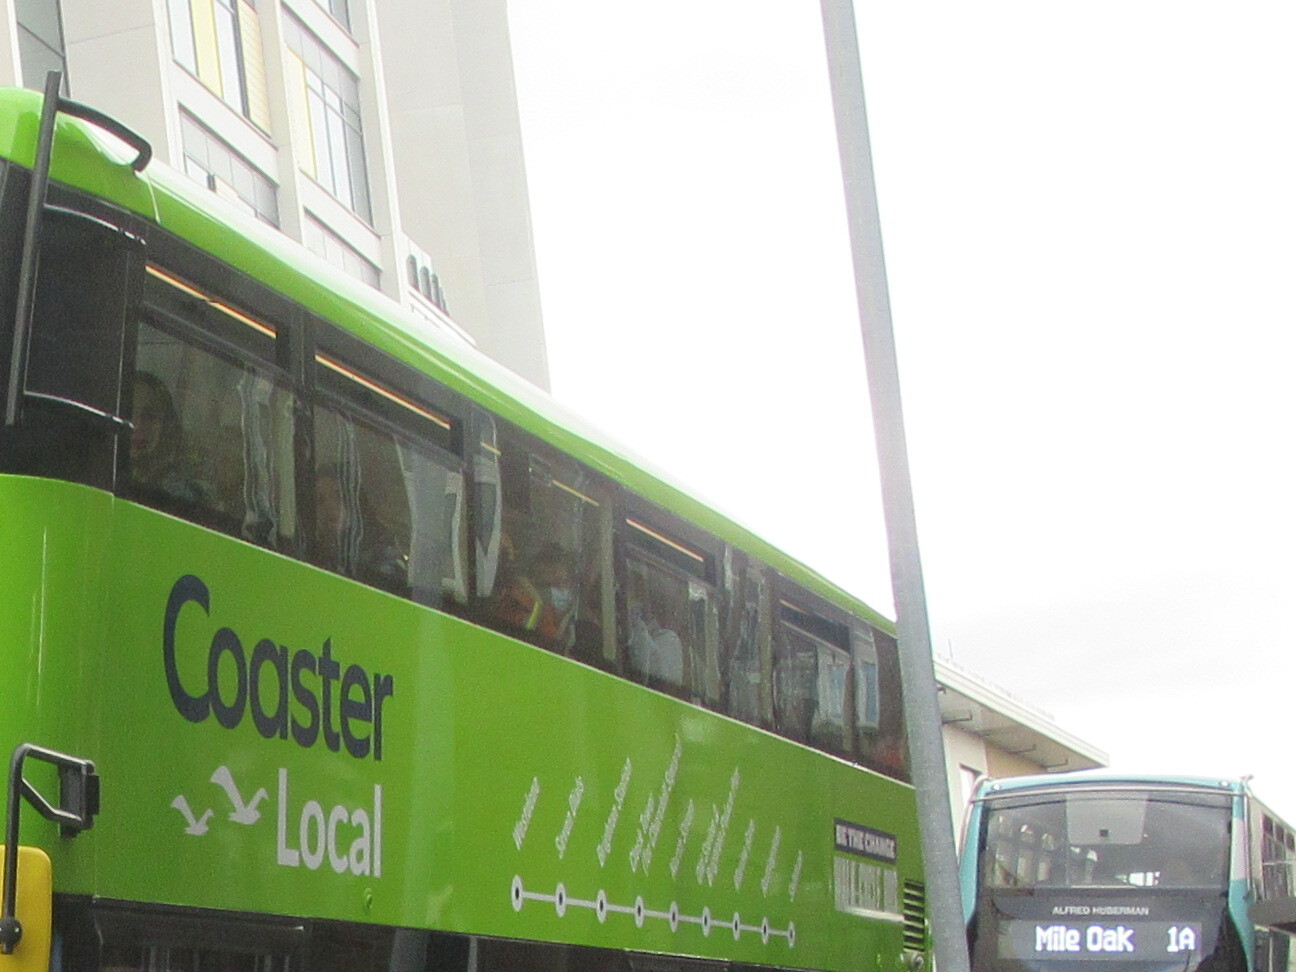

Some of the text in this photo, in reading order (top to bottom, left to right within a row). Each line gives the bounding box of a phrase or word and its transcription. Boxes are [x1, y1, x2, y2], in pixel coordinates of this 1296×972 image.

[163, 574, 394, 761] Coaster
[277, 768, 383, 878] Local
[1035, 924, 1196, 952] Mile Oak 1A
[1052, 906, 1090, 915] ALFRED
